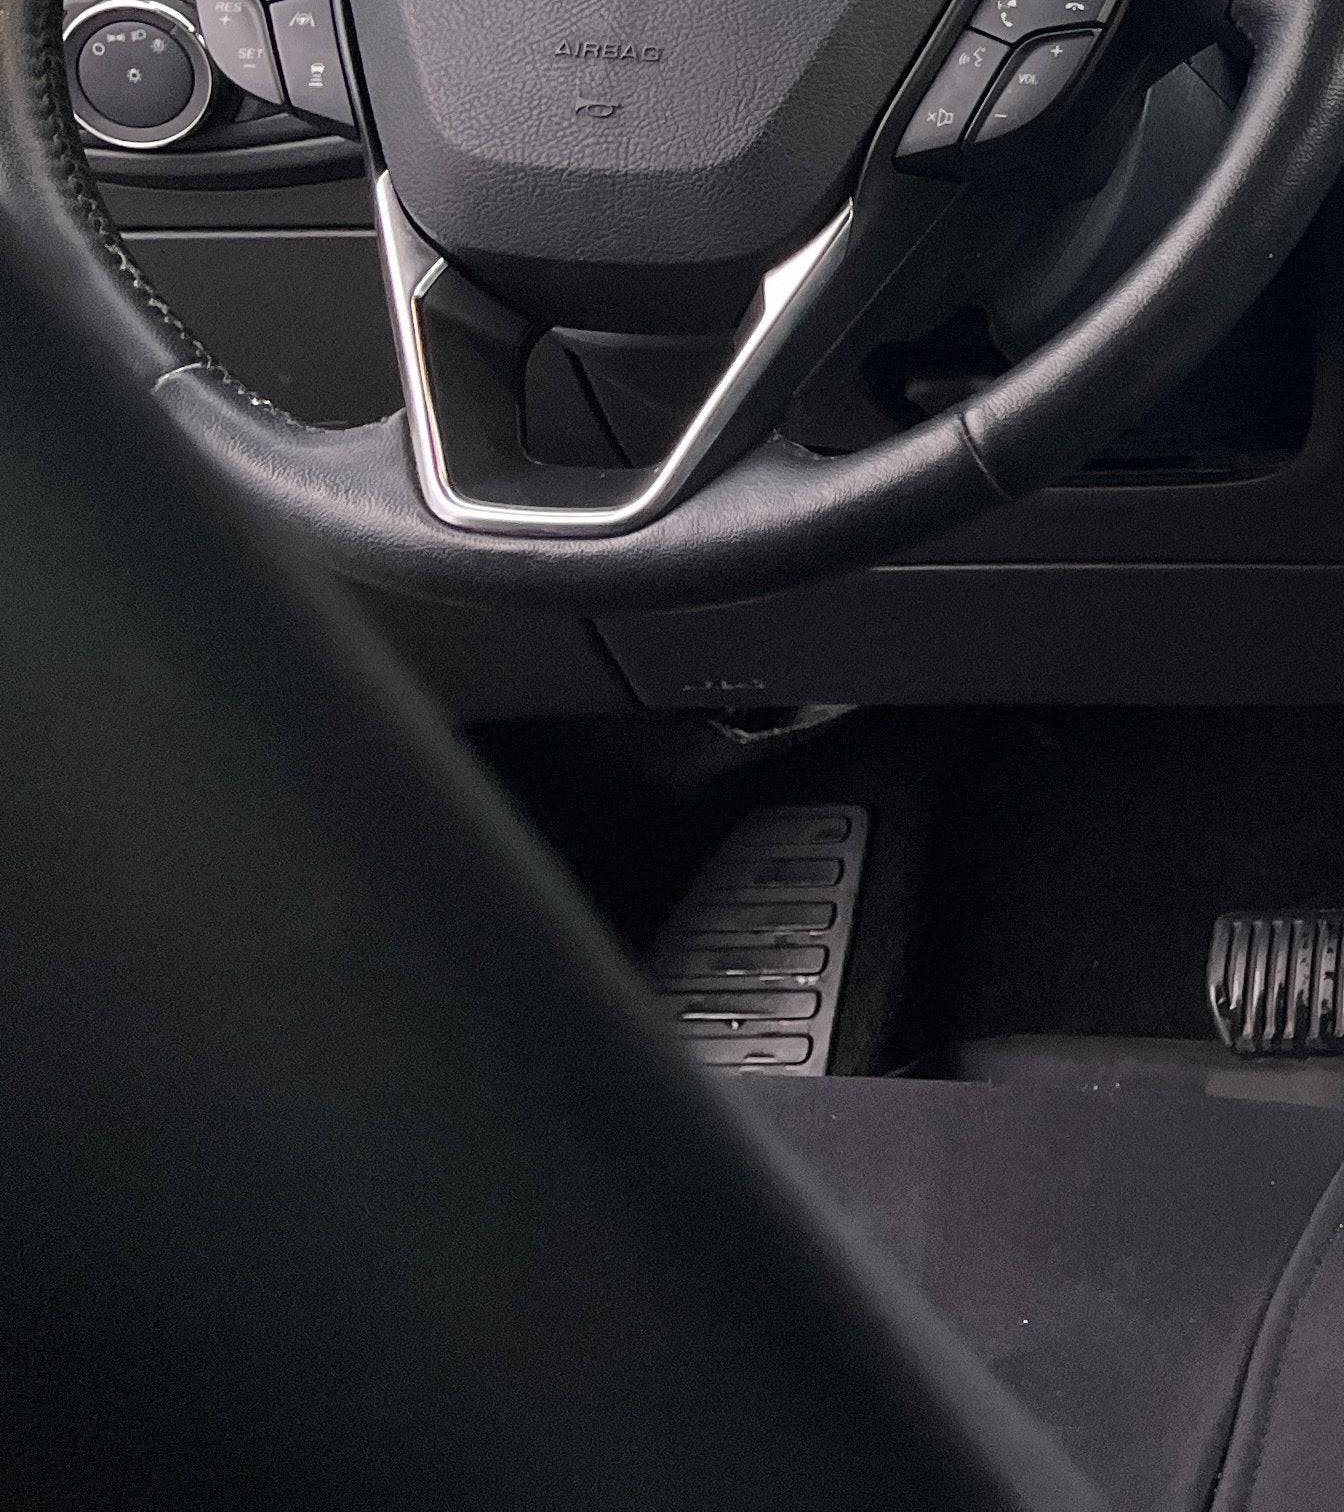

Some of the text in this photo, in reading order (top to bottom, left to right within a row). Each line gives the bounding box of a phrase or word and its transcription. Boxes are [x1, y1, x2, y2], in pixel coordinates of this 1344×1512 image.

[214, 1, 242, 13] RES
[238, 48, 264, 60] SET
[555, 39, 663, 63] AIRBAG
[1018, 73, 1039, 85] VOL
